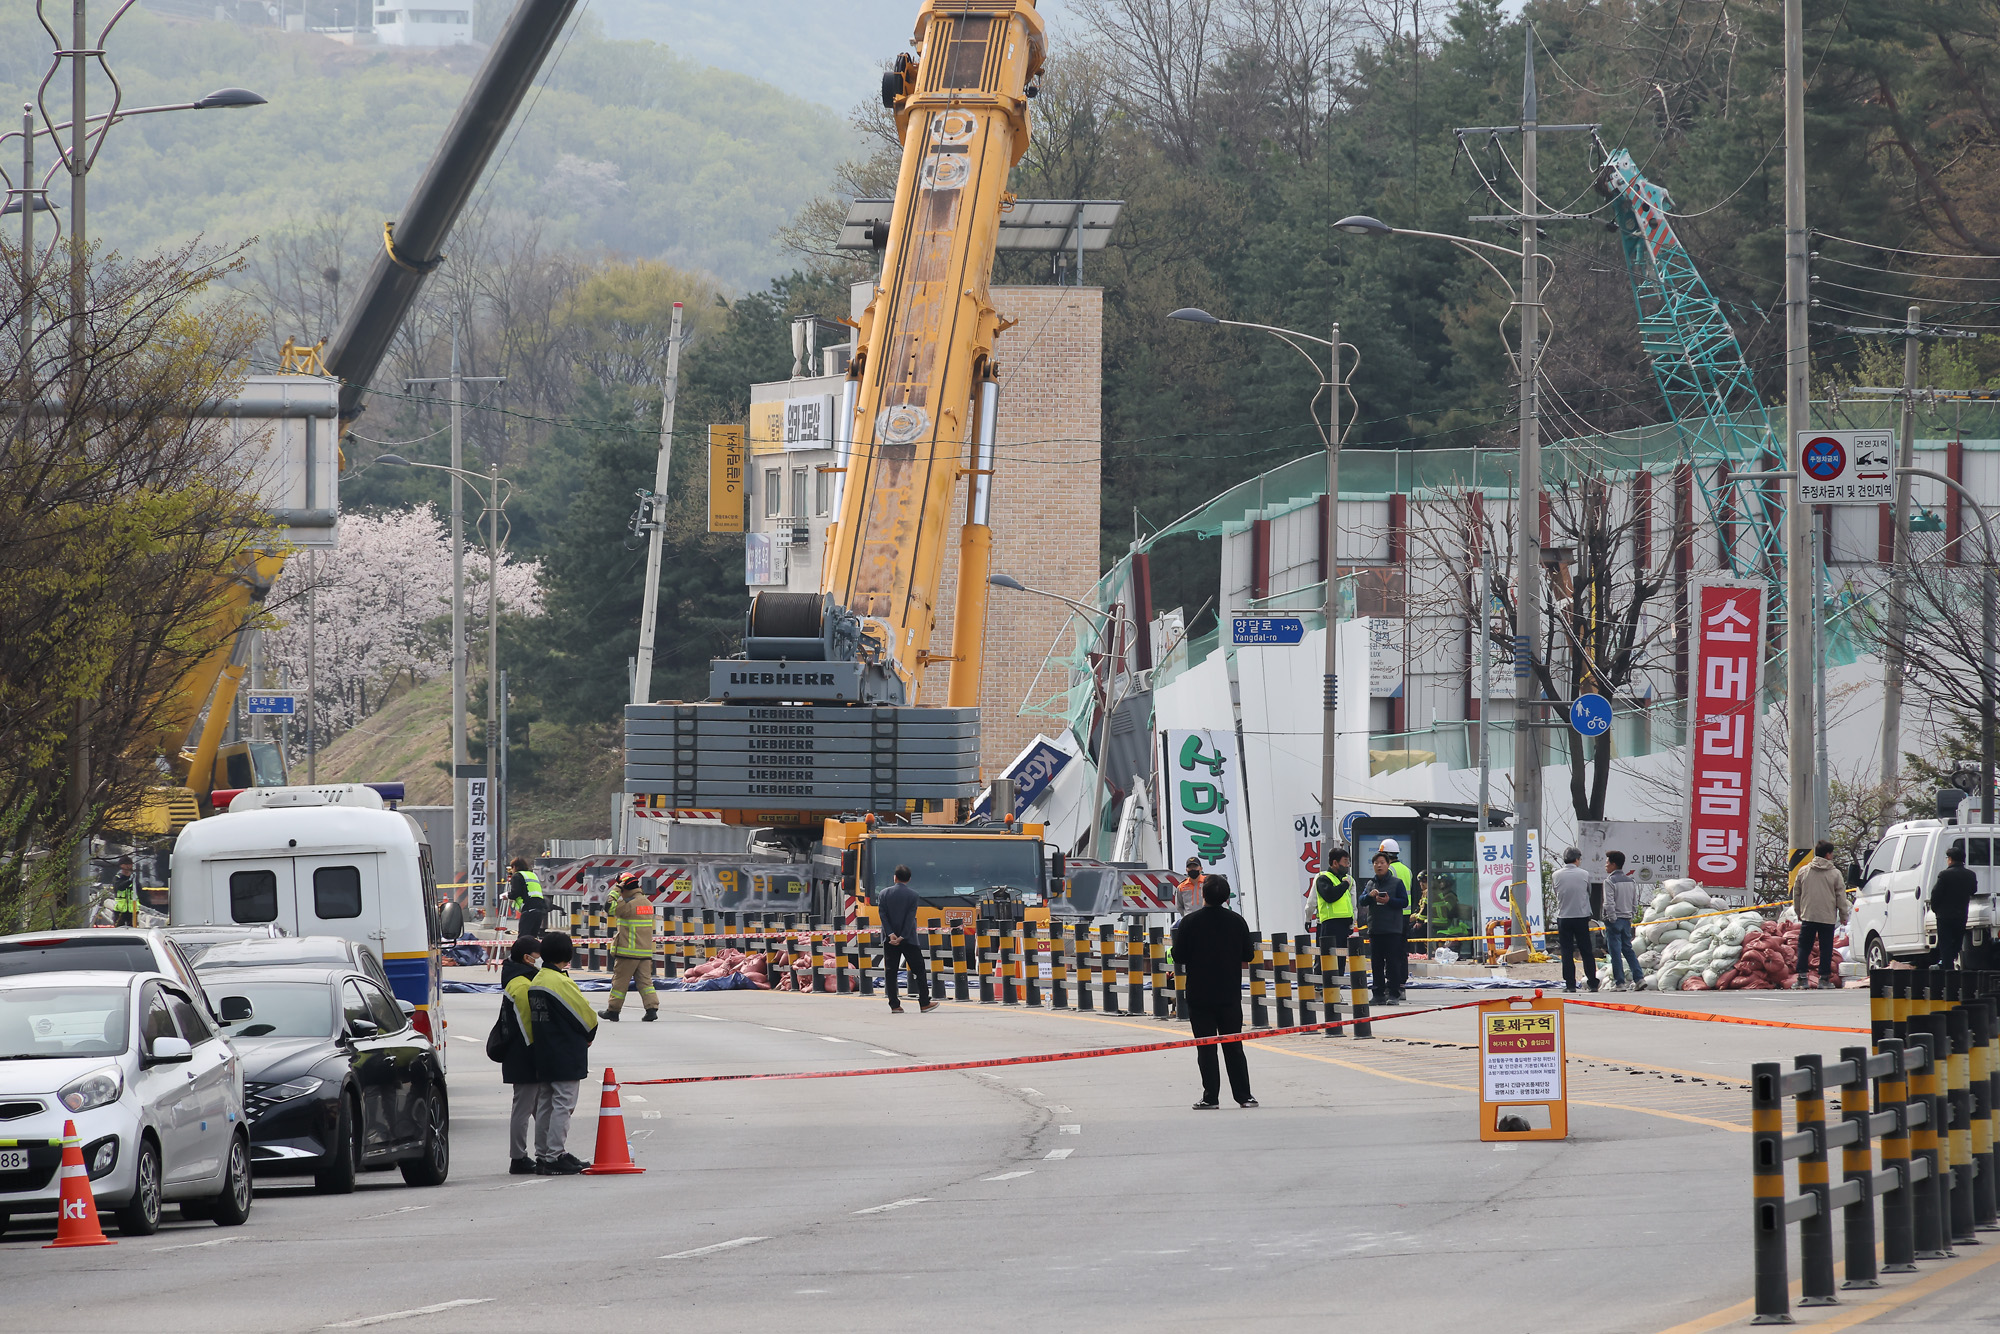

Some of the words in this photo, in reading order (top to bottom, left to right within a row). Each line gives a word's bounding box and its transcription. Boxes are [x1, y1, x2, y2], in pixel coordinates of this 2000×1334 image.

[1856, 440, 1887, 448] 견인지역
[1801, 485, 1844, 498] 주정차금지
[1847, 484, 1855, 498] 및
[1858, 483, 1892, 497] 견인지역
[1235, 620, 1272, 634] 양달로
[1234, 634, 1277, 643] Yangdal-ro
[730, 672, 835, 685] LIEBHERR
[250, 698, 276, 706] 오리로
[749, 709, 814, 719] LIEBHERR
[749, 725, 814, 735] LIEBHERR
[1697, 599, 1752, 873] 소머리곰탕
[749, 740, 814, 750] LIEBHERR
[749, 755, 814, 765] LIEBHERR
[749, 770, 814, 780] LIEBHERR
[1014, 748, 1059, 792] KCC
[749, 784, 814, 794] LIEBHERR
[471, 782, 486, 826] 테슬라
[1630, 854, 1676, 865] 오!베이비
[471, 832, 486, 906] 전문시공점
[1483, 861, 1536, 876] 서행하오
[1659, 864, 1681, 873] 스튜디
[1493, 1018, 1550, 1031] 통제구역
[63, 1198, 86, 1219] kt
